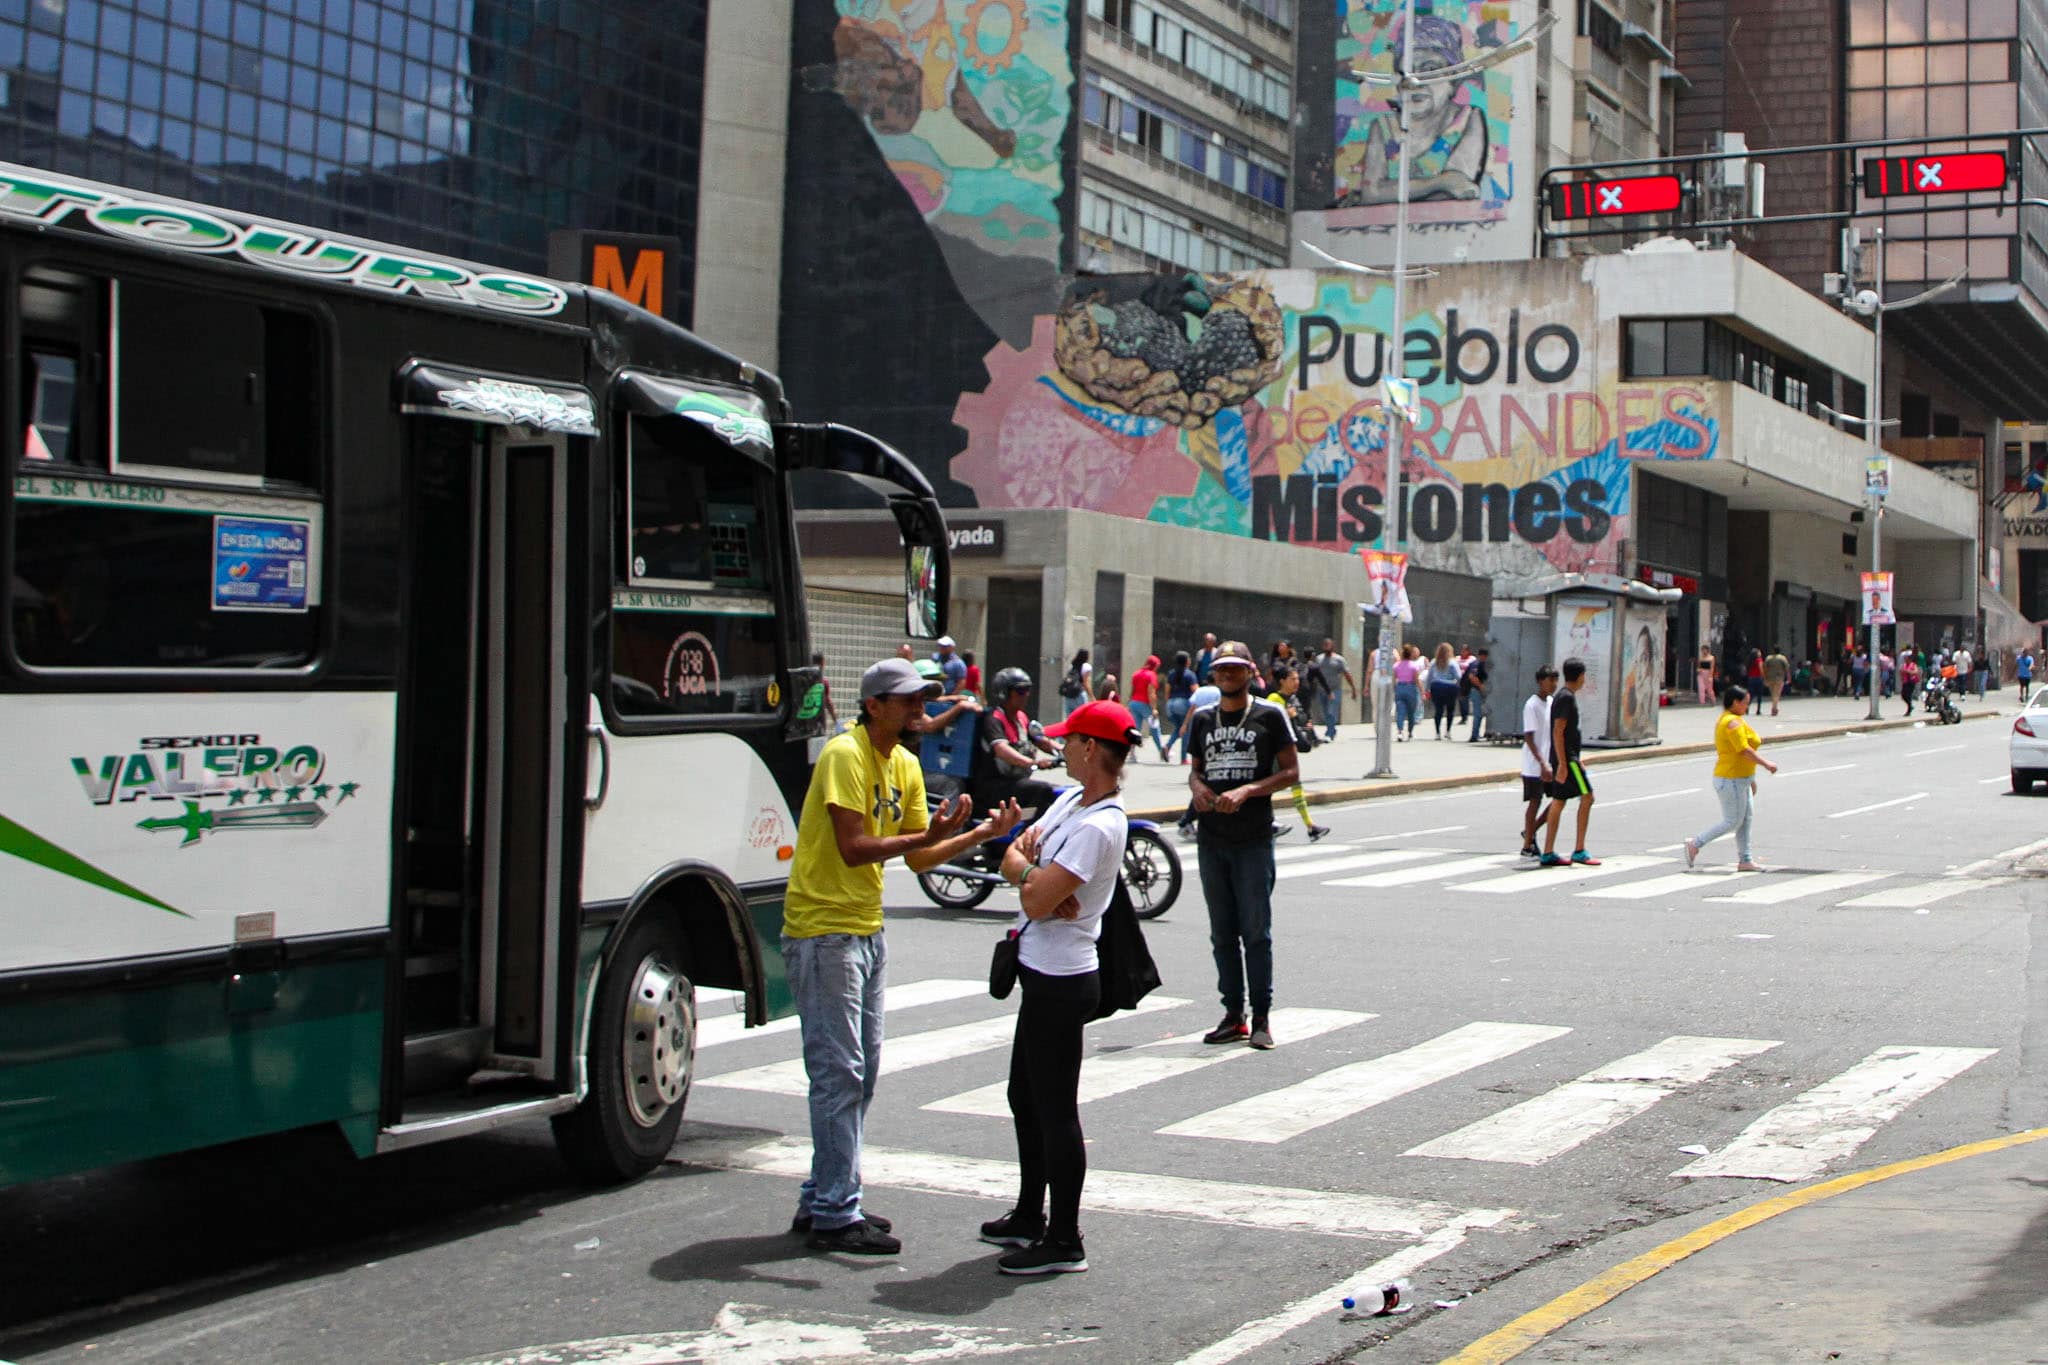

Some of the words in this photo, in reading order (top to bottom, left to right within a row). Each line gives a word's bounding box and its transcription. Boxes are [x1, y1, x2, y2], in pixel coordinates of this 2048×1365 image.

[0, 172, 568, 317] TOURS
[592, 244, 665, 317] M
[1299, 308, 1580, 391] Pueblo
[1271, 390, 1330, 446] de
[1339, 387, 1712, 461] GRANDES
[15, 476, 40, 494] EL
[51, 479, 77, 497] SR
[87, 480, 166, 503] VALERO
[947, 525, 995, 549] yada
[649, 592, 692, 609] VALERO
[1205, 726, 1257, 746] ADIDAS
[71, 745, 326, 805] VALERO
